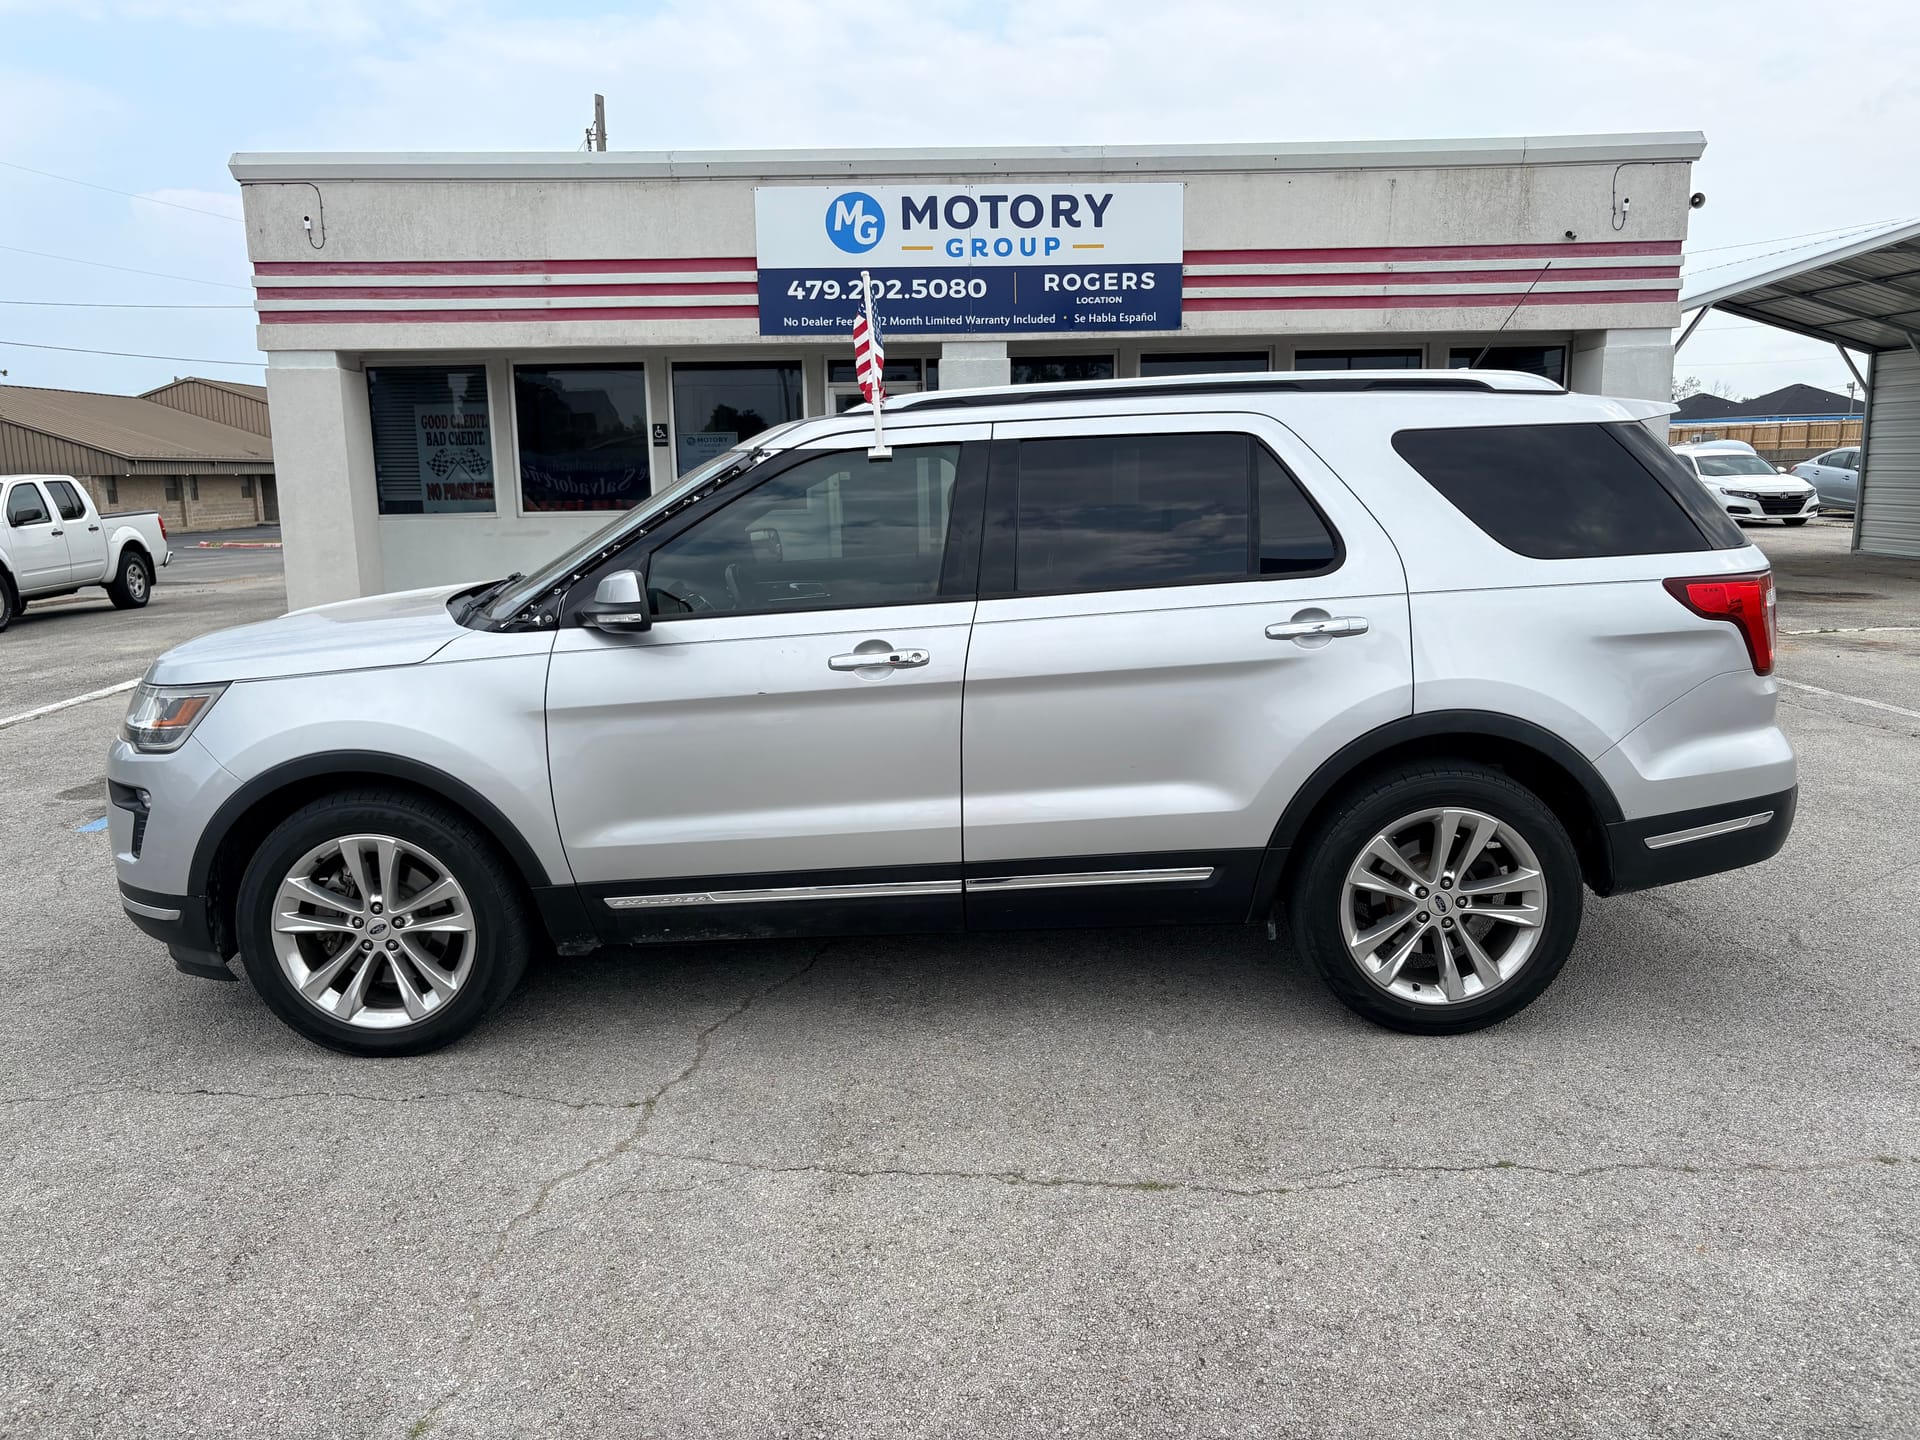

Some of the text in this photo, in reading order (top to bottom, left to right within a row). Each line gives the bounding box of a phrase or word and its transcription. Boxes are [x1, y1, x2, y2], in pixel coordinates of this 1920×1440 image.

[901, 194, 1114, 230] MOTORY
[834, 200, 878, 245] MG
[945, 237, 1061, 258] GROUP
[787, 279, 987, 300] 479.202.5080
[1044, 272, 1155, 291] ROGERS
[1076, 296, 1122, 304] LOCATION
[783, 317, 799, 326] No
[801, 316, 833, 326] Dealer
[836, 317, 855, 326] Fee
[890, 315, 922, 326] Month
[925, 315, 963, 325] Limited
[965, 314, 1010, 326] Warranty
[1013, 313, 1056, 324] Included
[1074, 313, 1086, 323] Se
[1089, 312, 1117, 323] Habla
[1119, 312, 1157, 325] Español
[421, 414, 448, 429] GOOD
[425, 431, 486, 446] BAD CREDIT.
